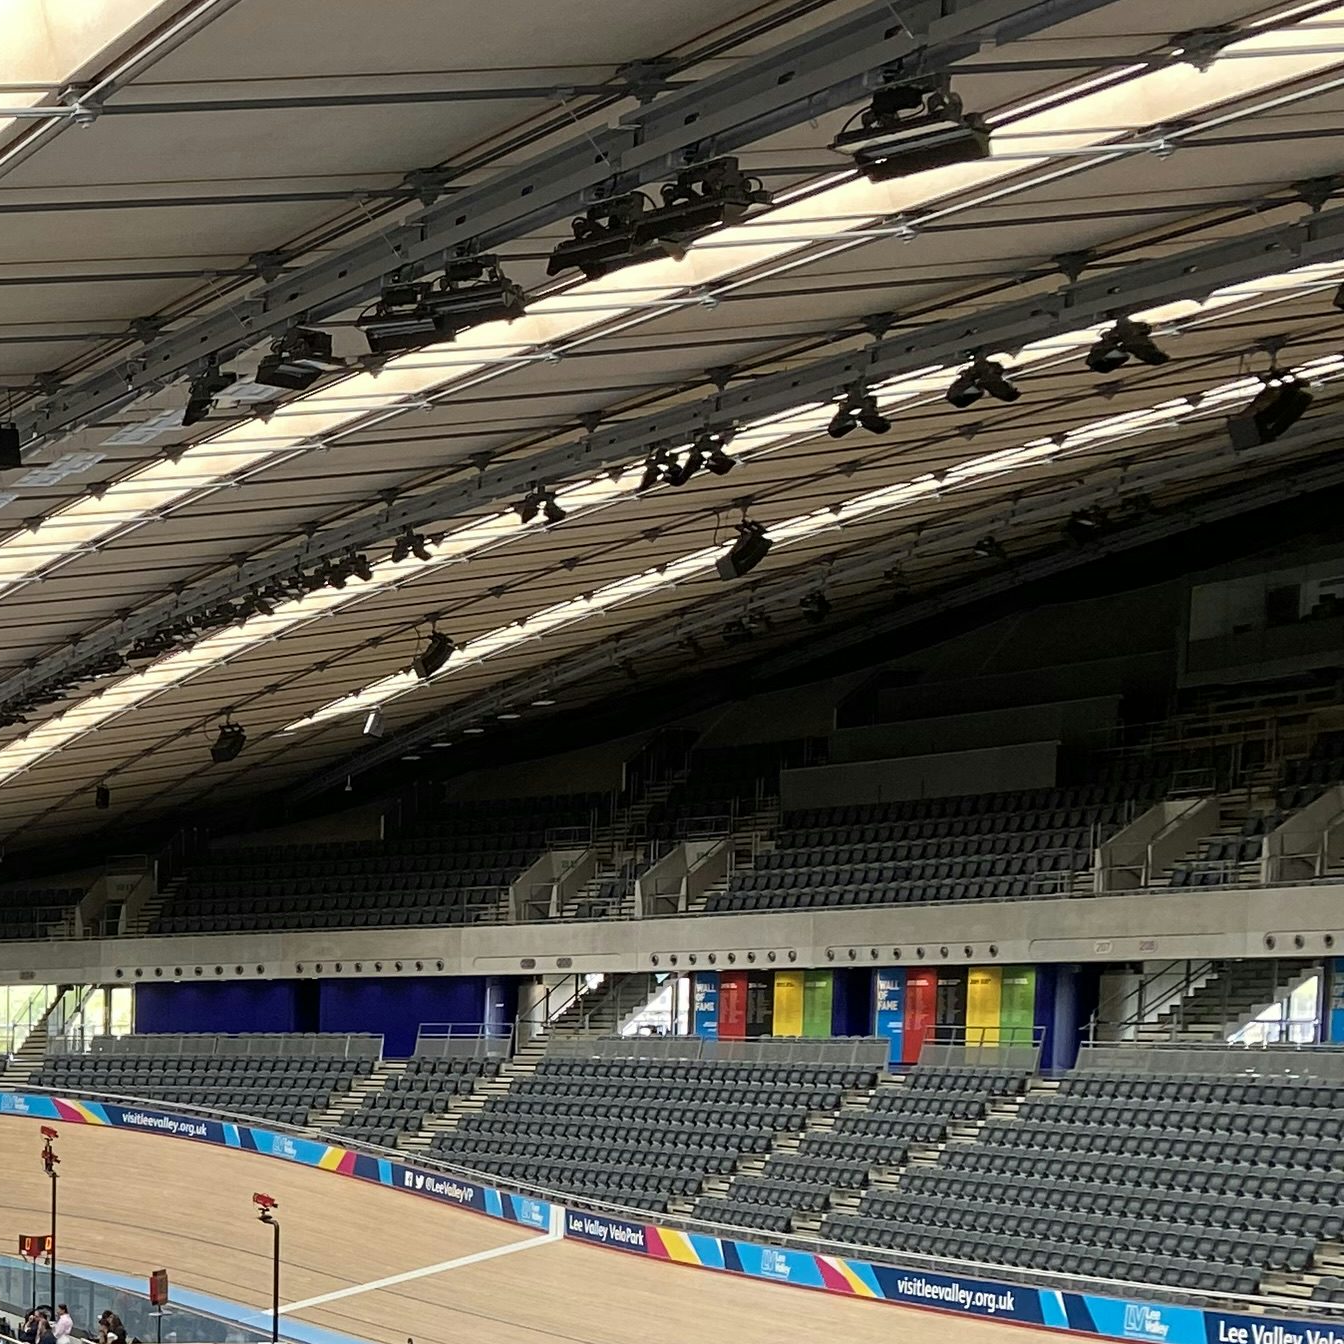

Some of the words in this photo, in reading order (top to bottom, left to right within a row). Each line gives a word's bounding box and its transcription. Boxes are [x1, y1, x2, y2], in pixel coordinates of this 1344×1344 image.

[696, 983, 716, 992] WALL
[880, 980, 899, 990] WALL
[696, 993, 705, 1001] OF
[879, 991, 888, 1000] OF
[696, 1002, 715, 1011] FAME
[879, 1001, 898, 1011] FAME
[122, 1110, 207, 1137] visitleevalley.org.uk
[423, 1177, 474, 1203] @LeeValleyVP
[568, 1214, 583, 1232] Lee
[584, 1219, 609, 1240] Valley
[609, 1224, 644, 1246] VeloPark
[898, 1276, 1015, 1311] visitleevalley.org.uk
[1145, 1306, 1161, 1320] Lee
[1145, 1320, 1169, 1337] Valley
[1219, 1320, 1248, 1344] Lee
